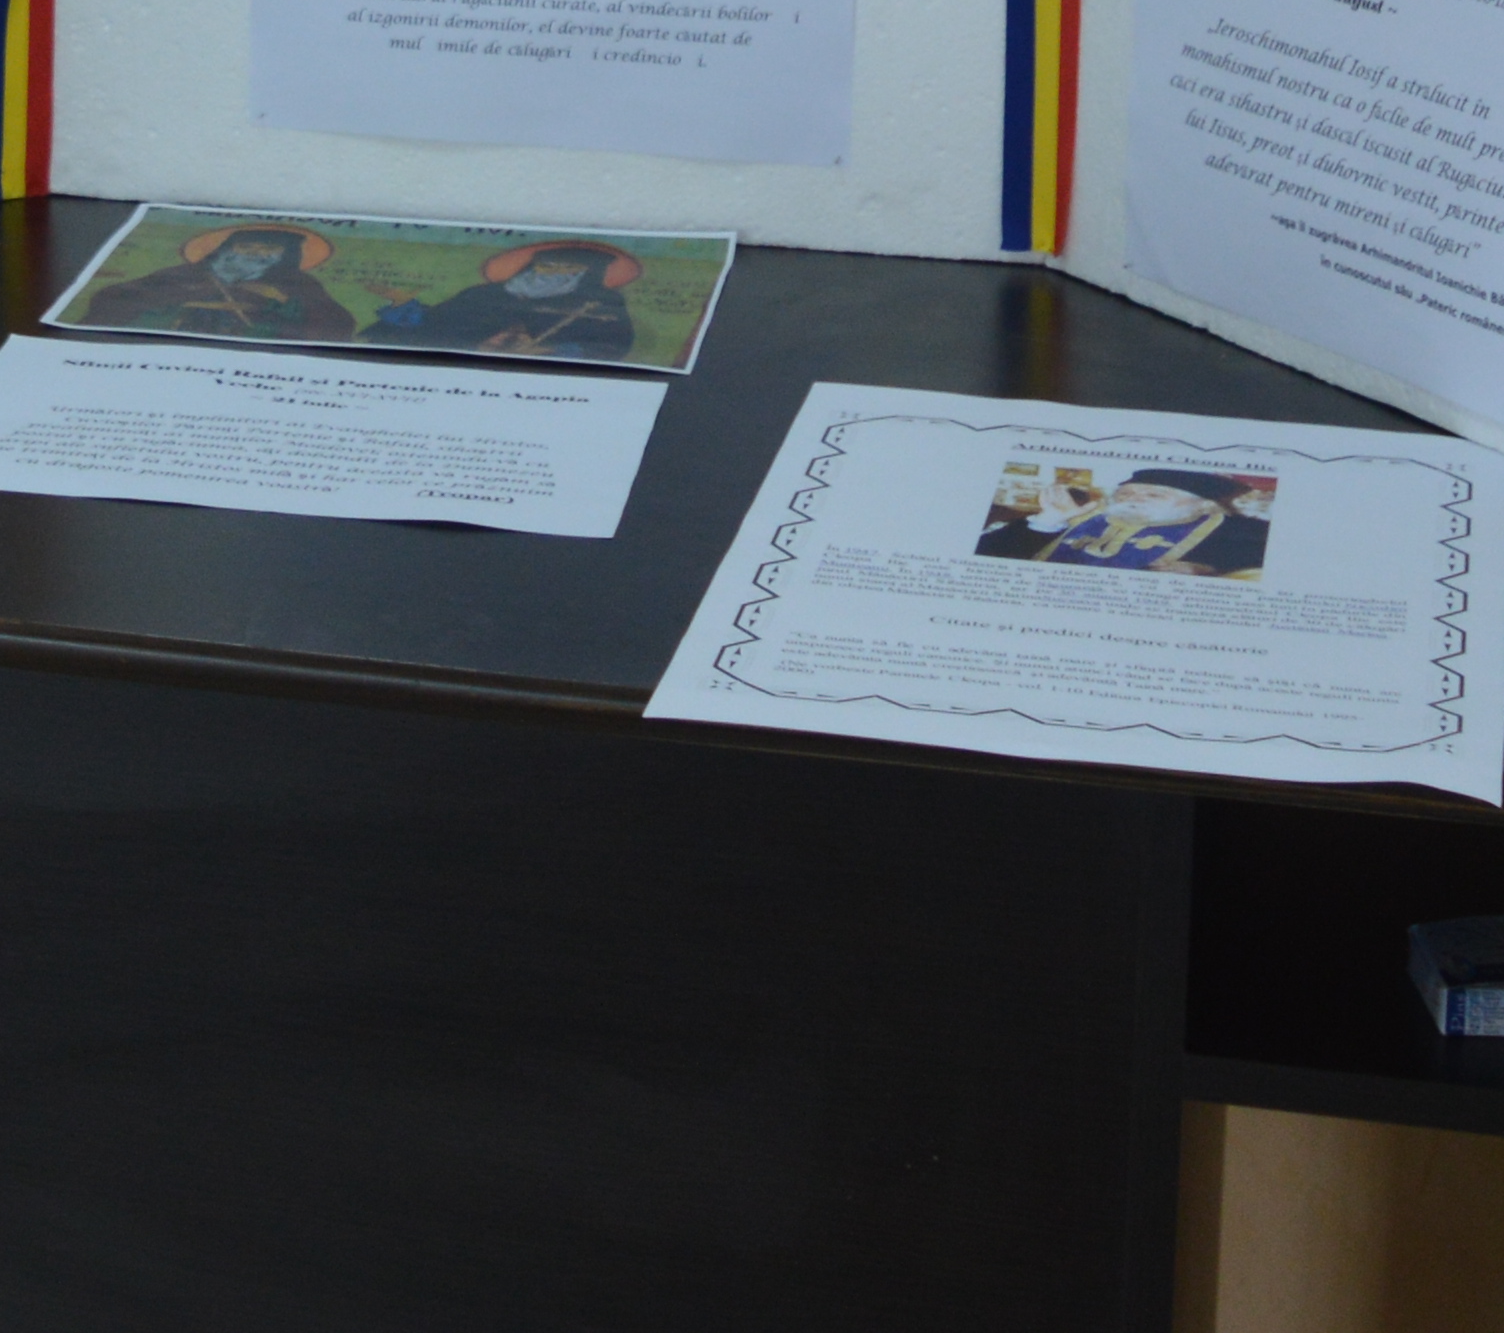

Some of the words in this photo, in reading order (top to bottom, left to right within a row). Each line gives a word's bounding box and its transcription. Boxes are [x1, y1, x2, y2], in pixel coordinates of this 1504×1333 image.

[445, 386, 474, 395] de
[480, 388, 500, 397] la
[929, 615, 991, 629] Citate
[1020, 626, 1093, 639] predici
[1100, 633, 1168, 648] despre
